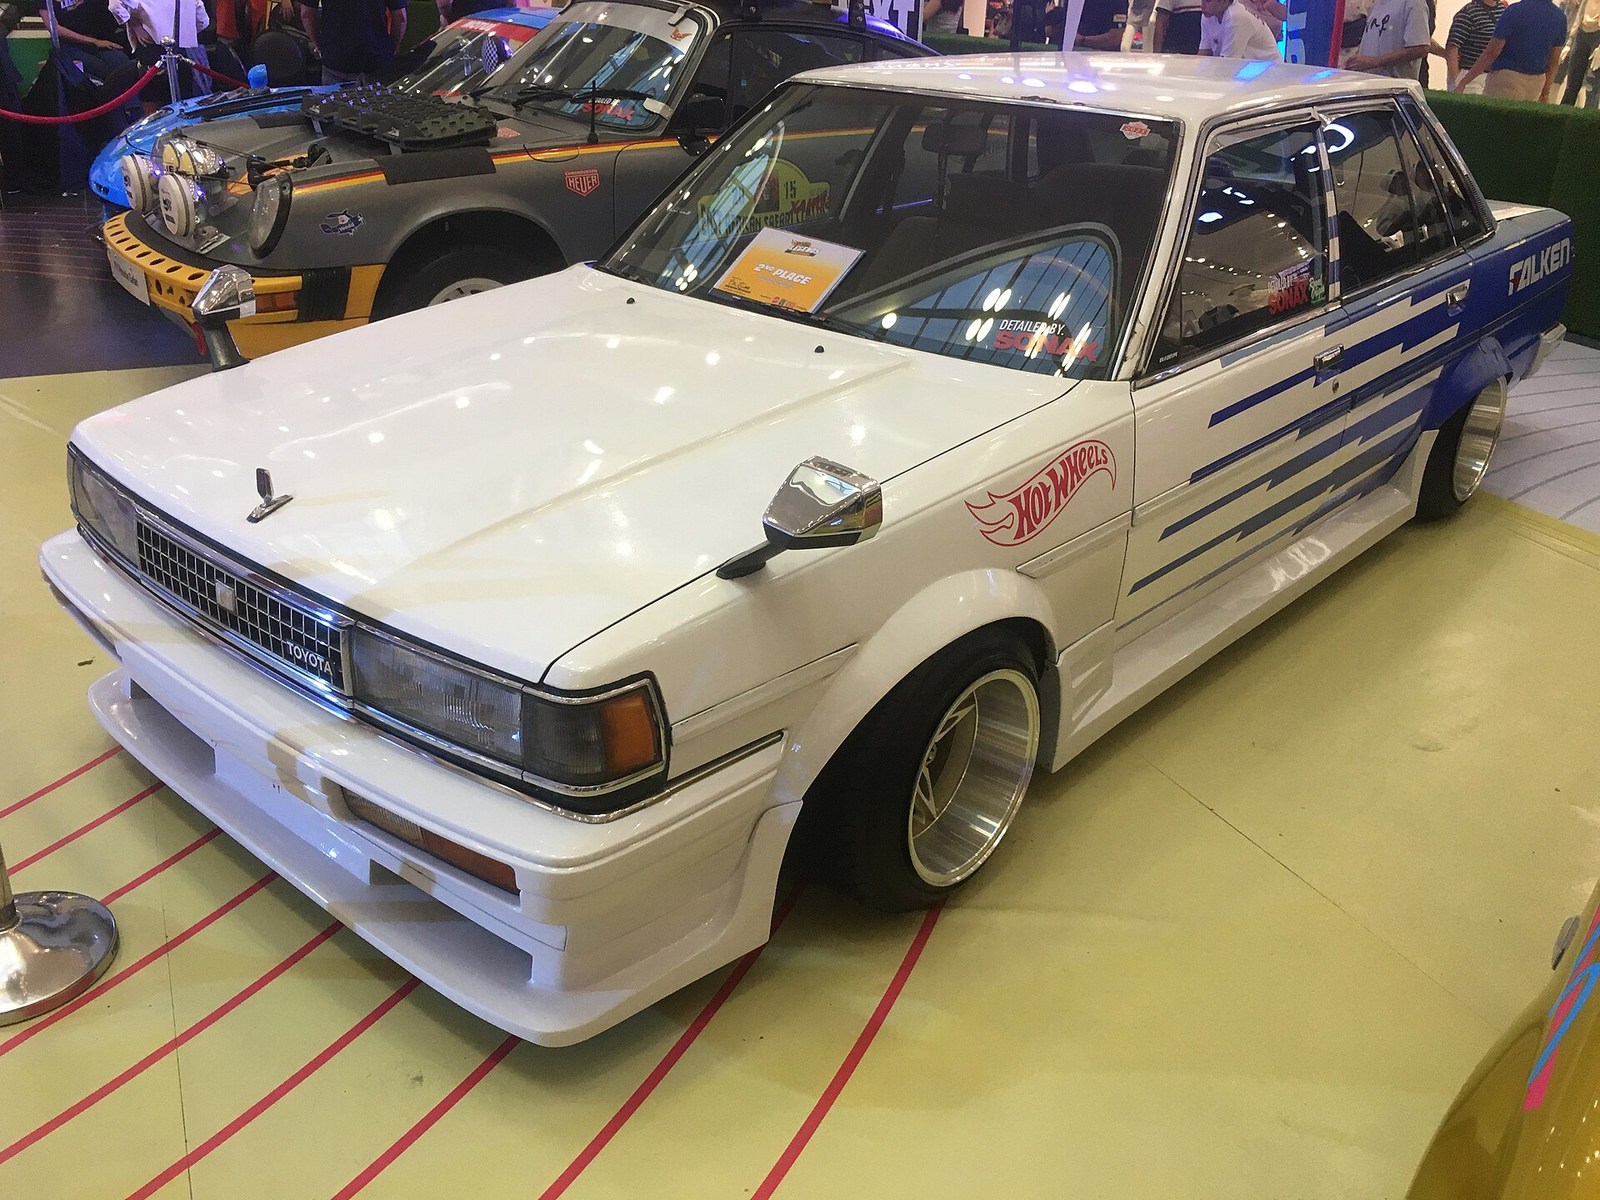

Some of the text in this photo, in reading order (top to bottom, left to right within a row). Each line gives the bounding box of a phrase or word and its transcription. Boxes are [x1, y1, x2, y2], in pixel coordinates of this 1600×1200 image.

[568, 175, 598, 194] HEUER
[784, 181, 797, 200] 15
[754, 263, 774, 273] 2ND
[772, 268, 812, 285] PLACE
[1508, 238, 1570, 296] FALKEN
[1268, 280, 1309, 314] SONAX
[999, 319, 1048, 333] DETAILED
[993, 330, 1098, 362] SONAX
[1006, 481, 1052, 540] HOT
[286, 641, 333, 676] TOYOTA
